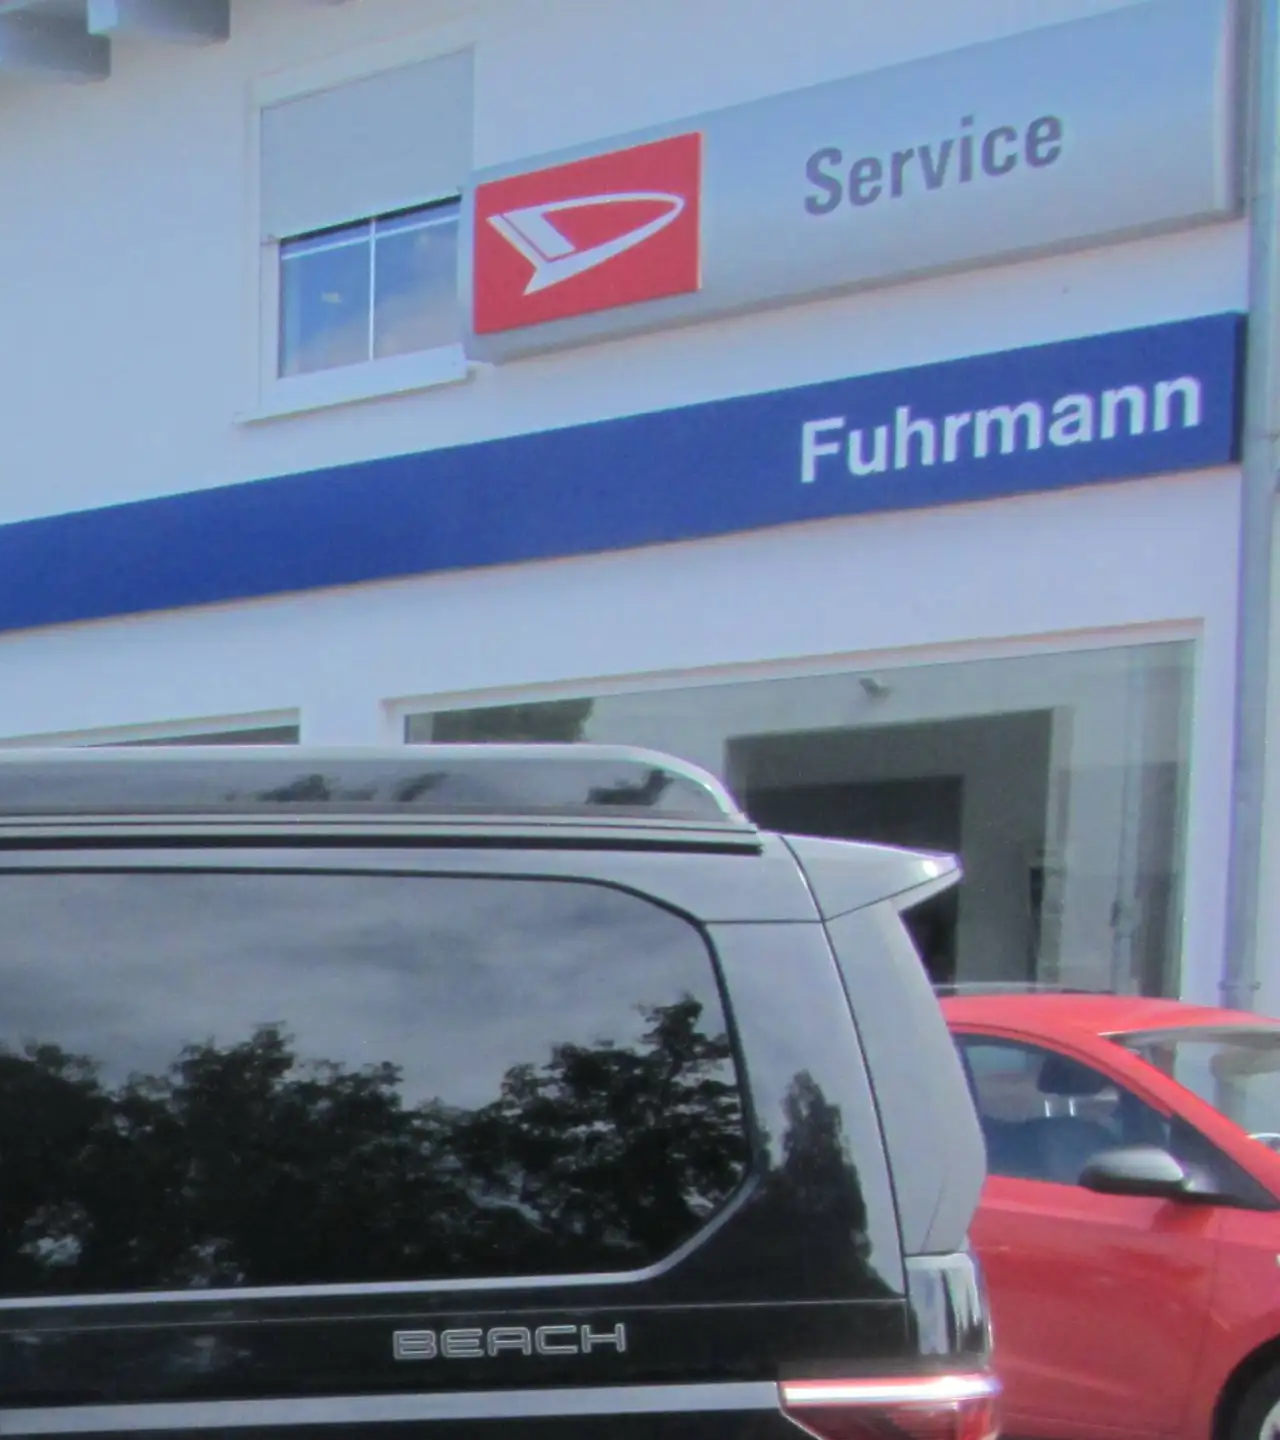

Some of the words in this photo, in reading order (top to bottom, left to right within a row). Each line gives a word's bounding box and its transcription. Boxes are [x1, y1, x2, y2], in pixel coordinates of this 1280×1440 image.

[804, 113, 1063, 216] Service
[801, 374, 1202, 484] Fuhrmann
[392, 1322, 627, 1361] BEACH
